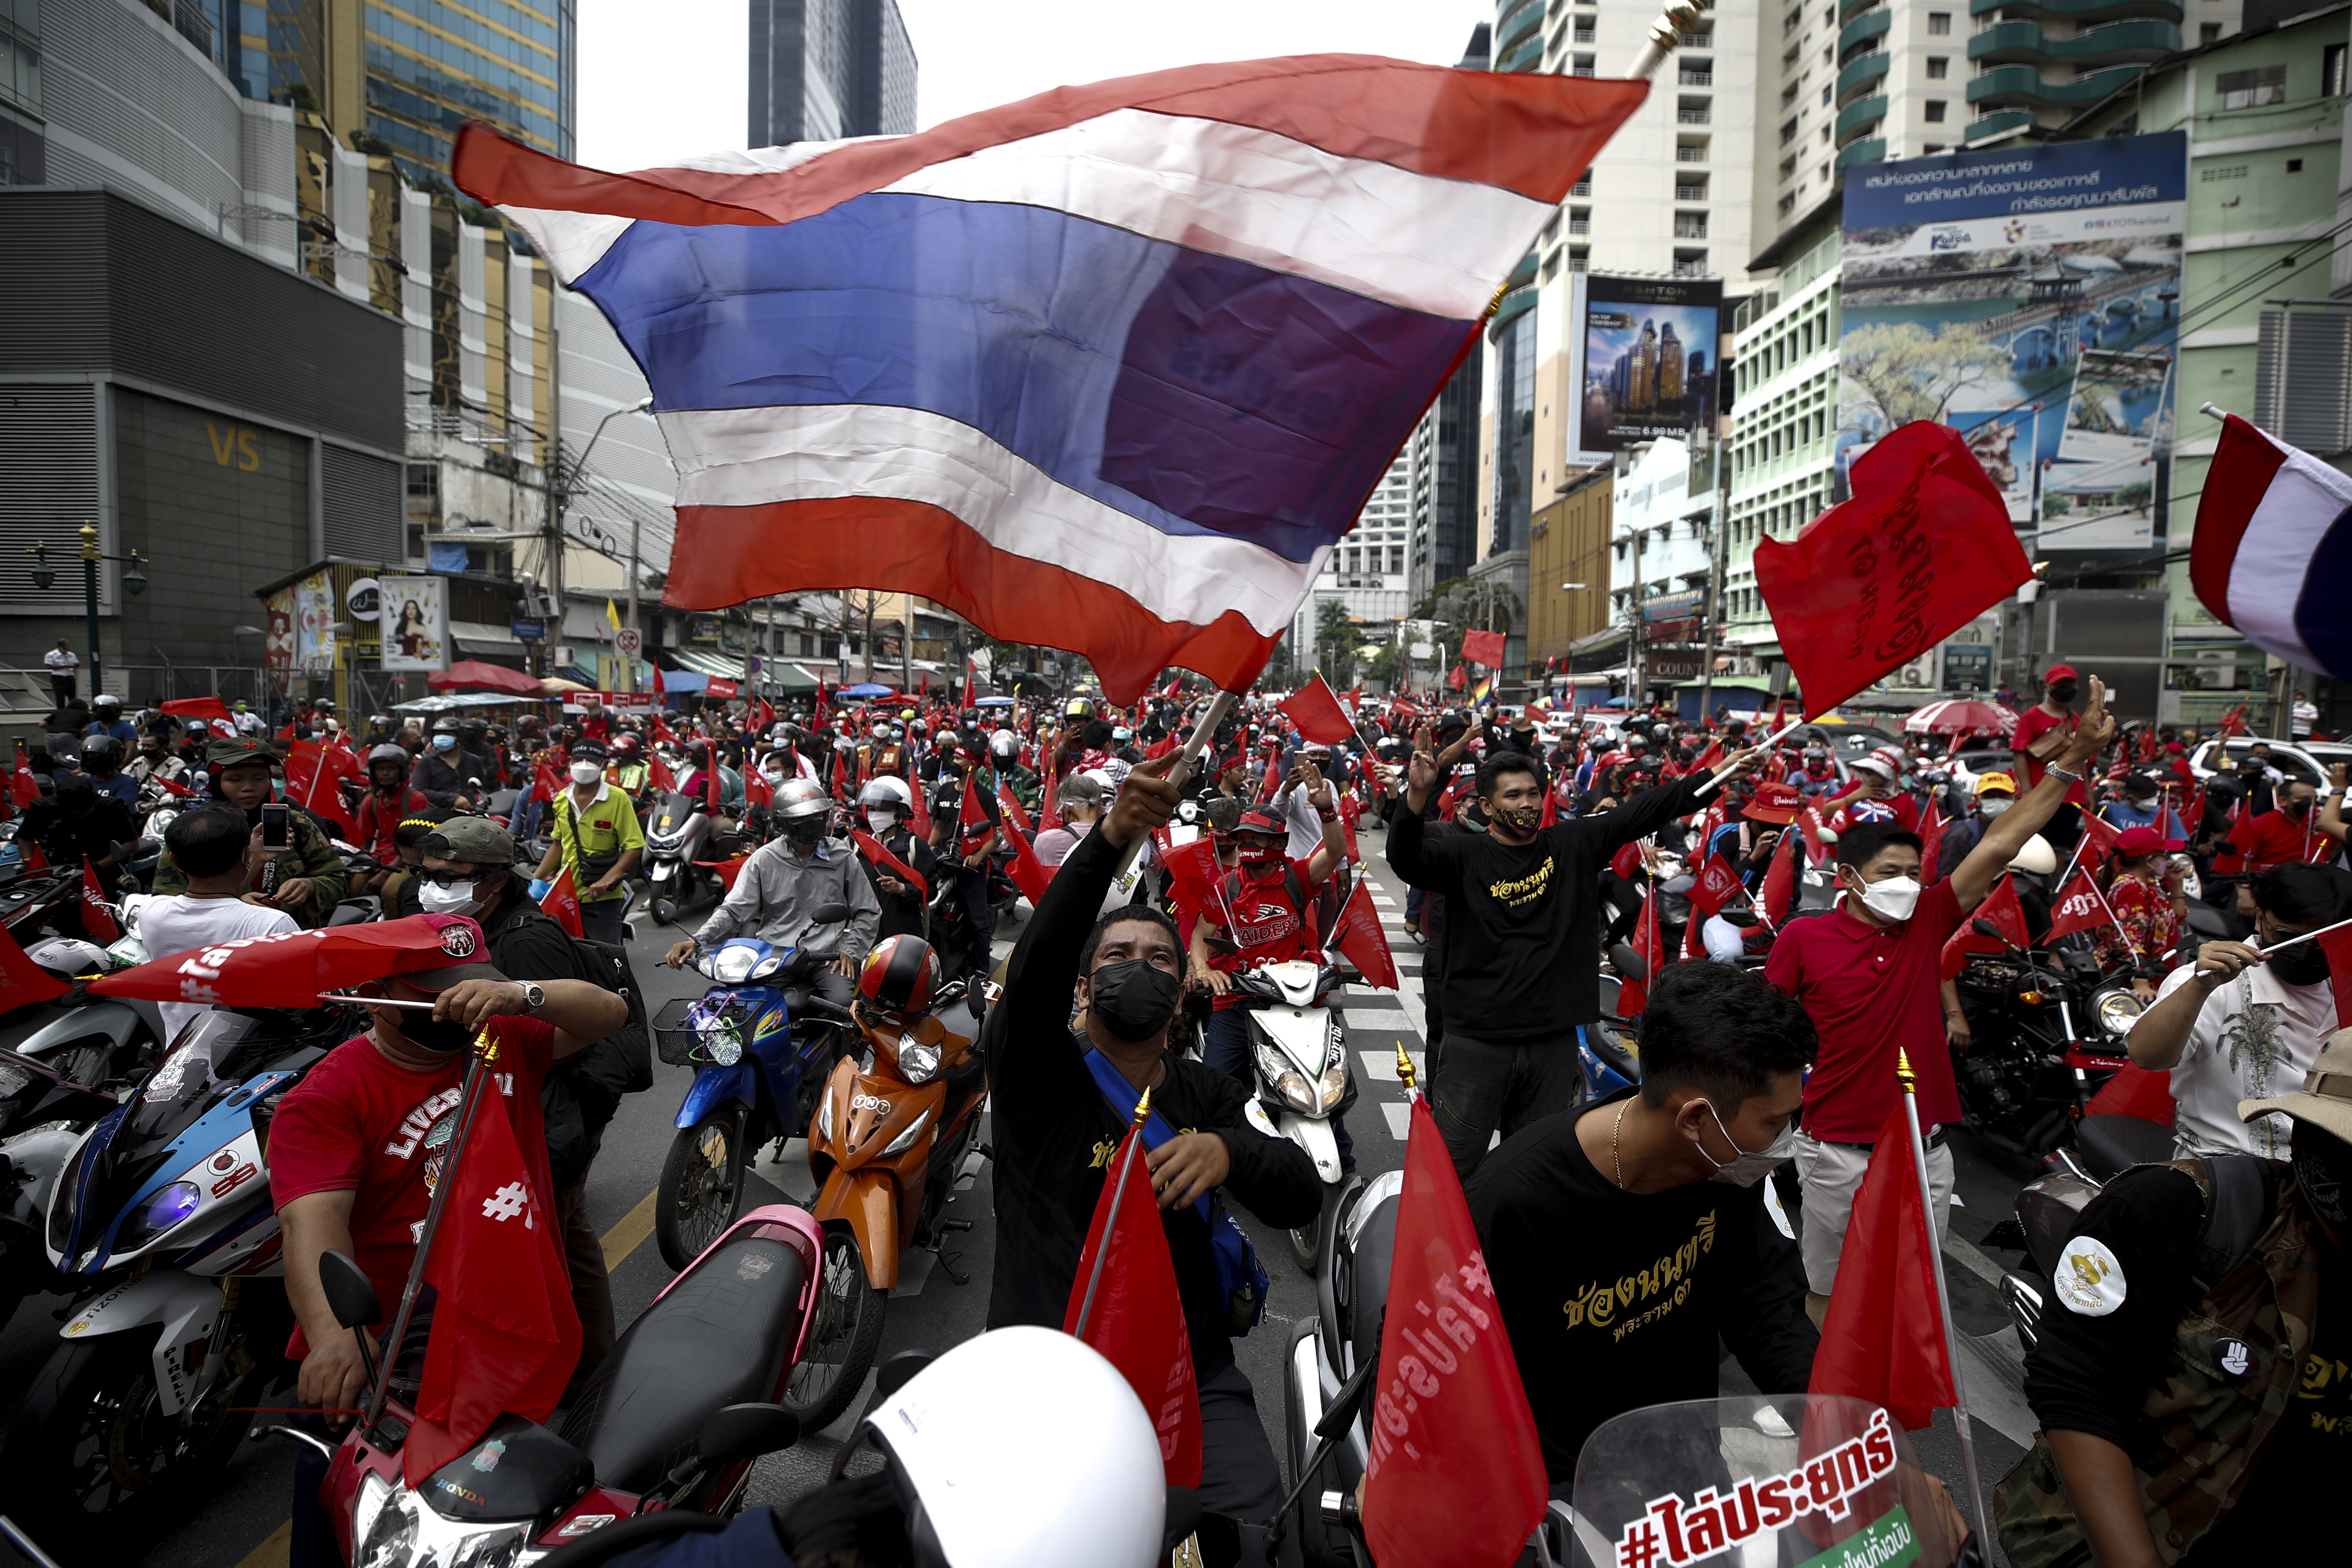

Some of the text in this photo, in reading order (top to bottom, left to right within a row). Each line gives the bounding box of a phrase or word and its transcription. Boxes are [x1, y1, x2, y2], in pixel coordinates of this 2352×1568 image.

[1622, 285, 1687, 297] ASHTON
[1641, 426, 1686, 436] 6.99 MB
[205, 421, 260, 472] VS
[882, 753, 894, 763] 25
[1125, 873, 1135, 887] GAS
[385, 1072, 514, 1160] LIVEROL
[854, 1096, 889, 1112] TNT
[746, 1246, 782, 1262] LIVERPOOL
[1562, 1209, 1717, 1331] ช่องนนทรี
[86, 1277, 142, 1319] rizoma
[1613, 1300, 1673, 1343] พระราม
[164, 1346, 186, 1406] PIRELLI
[436, 1478, 486, 1508] HONDA
